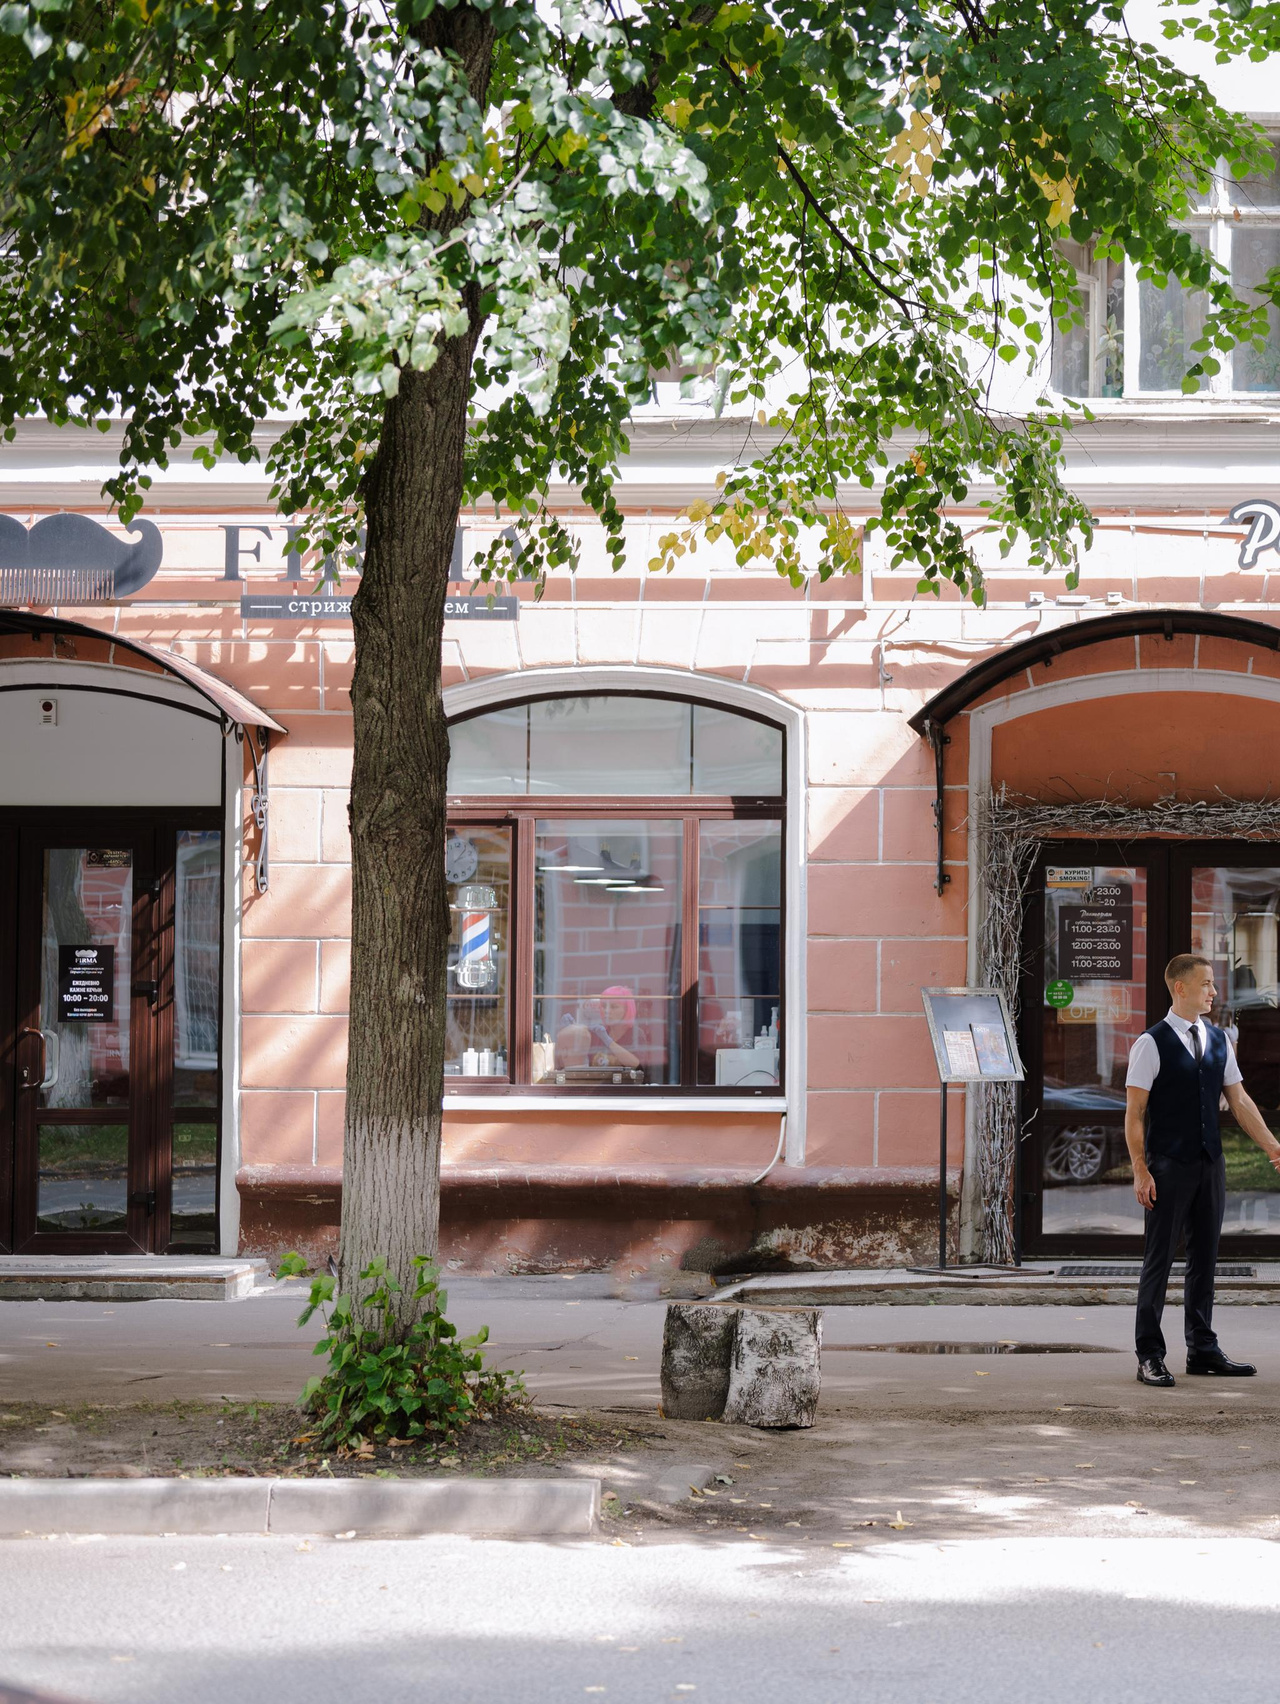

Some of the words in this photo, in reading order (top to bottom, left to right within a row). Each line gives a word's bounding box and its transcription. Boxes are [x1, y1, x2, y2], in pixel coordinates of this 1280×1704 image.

[288, 601, 352, 614] стриж
[63, 994, 82, 1002] 10:00
[88, 994, 109, 1002] 20:00
[1070, 1005, 1119, 1018] OPEN
